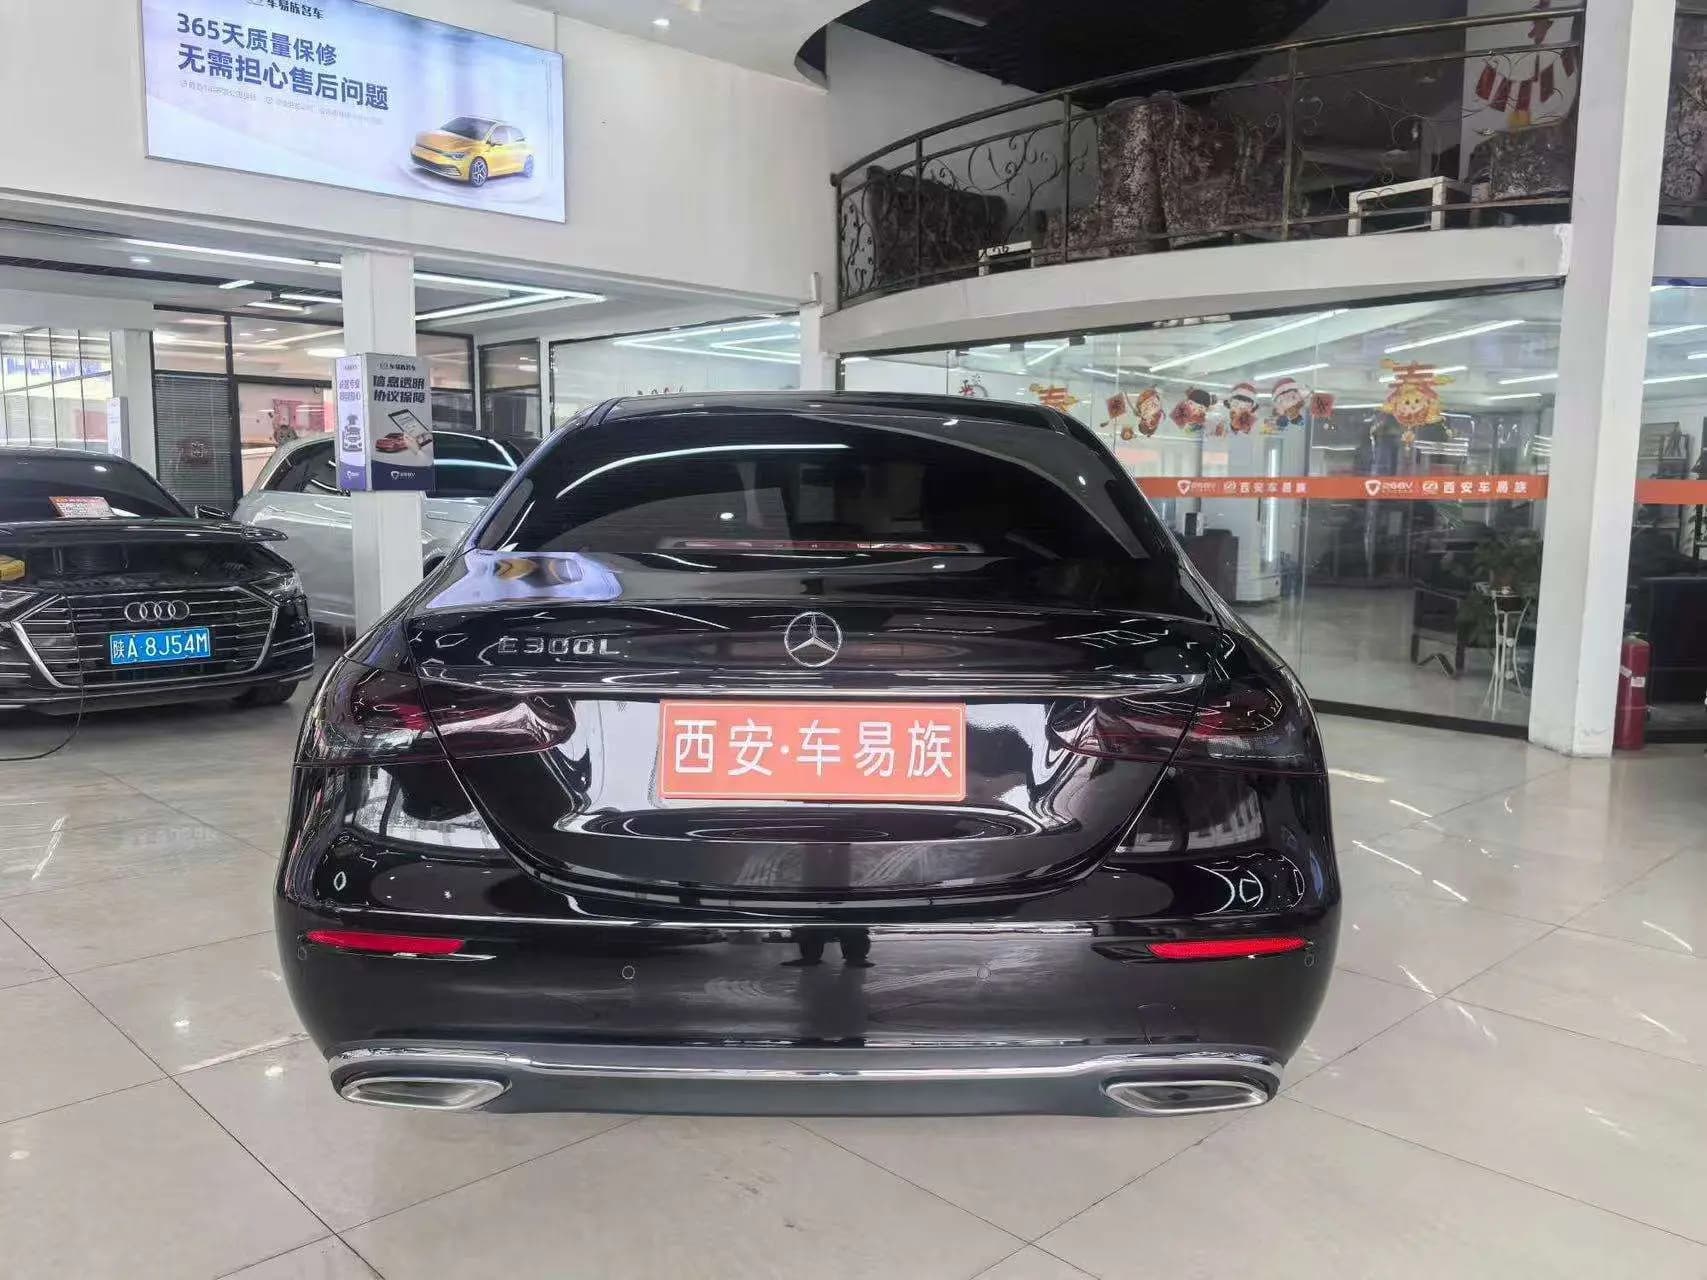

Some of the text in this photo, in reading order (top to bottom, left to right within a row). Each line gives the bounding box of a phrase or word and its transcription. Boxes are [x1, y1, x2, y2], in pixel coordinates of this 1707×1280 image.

[176, 13, 337, 66] 365天质量保修
[178, 43, 389, 110] 无需担心售后问题
[373, 375, 425, 389] 信息透明
[374, 389, 425, 403] 协议保障
[1444, 481, 1527, 493] 西安车易族
[498, 636, 620, 655] E300L
[673, 718, 953, 779] 西安·车易族
